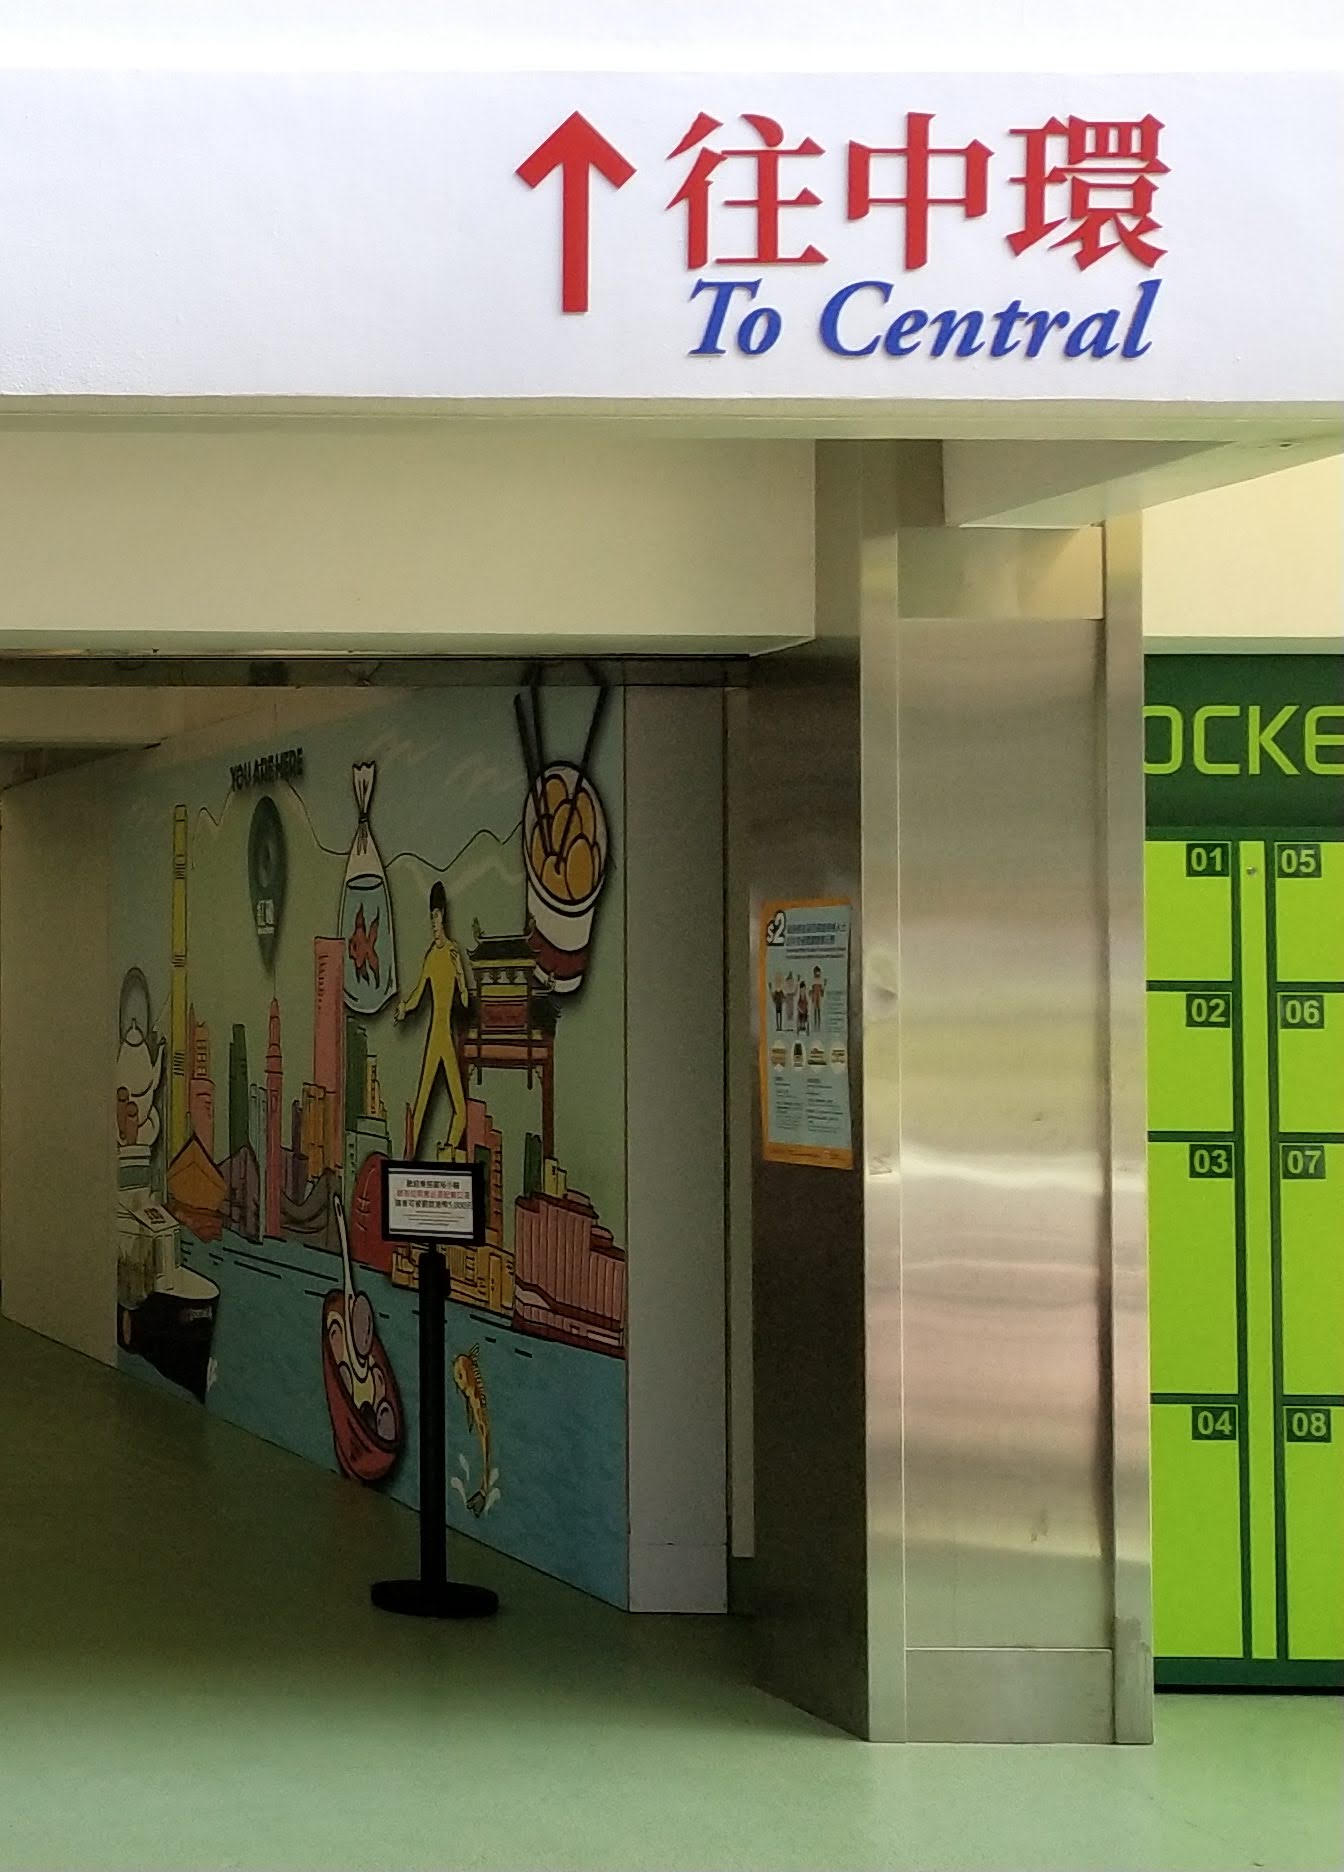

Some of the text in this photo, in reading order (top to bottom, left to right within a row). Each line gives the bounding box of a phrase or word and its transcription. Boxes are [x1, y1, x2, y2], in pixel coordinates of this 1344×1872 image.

[666, 111, 1171, 272] 往中環
[688, 277, 1162, 360] To Central
[229, 747, 303, 792] YOU ARE HERE
[1190, 847, 1225, 873] 01
[1281, 848, 1317, 874] 05
[766, 909, 787, 947] $2
[1191, 998, 1226, 1023] 02
[1285, 1000, 1320, 1025] 06
[1193, 1149, 1228, 1174] 03
[1287, 1150, 1322, 1174] 07
[1197, 1410, 1232, 1435] 04
[1292, 1412, 1327, 1437] 08
